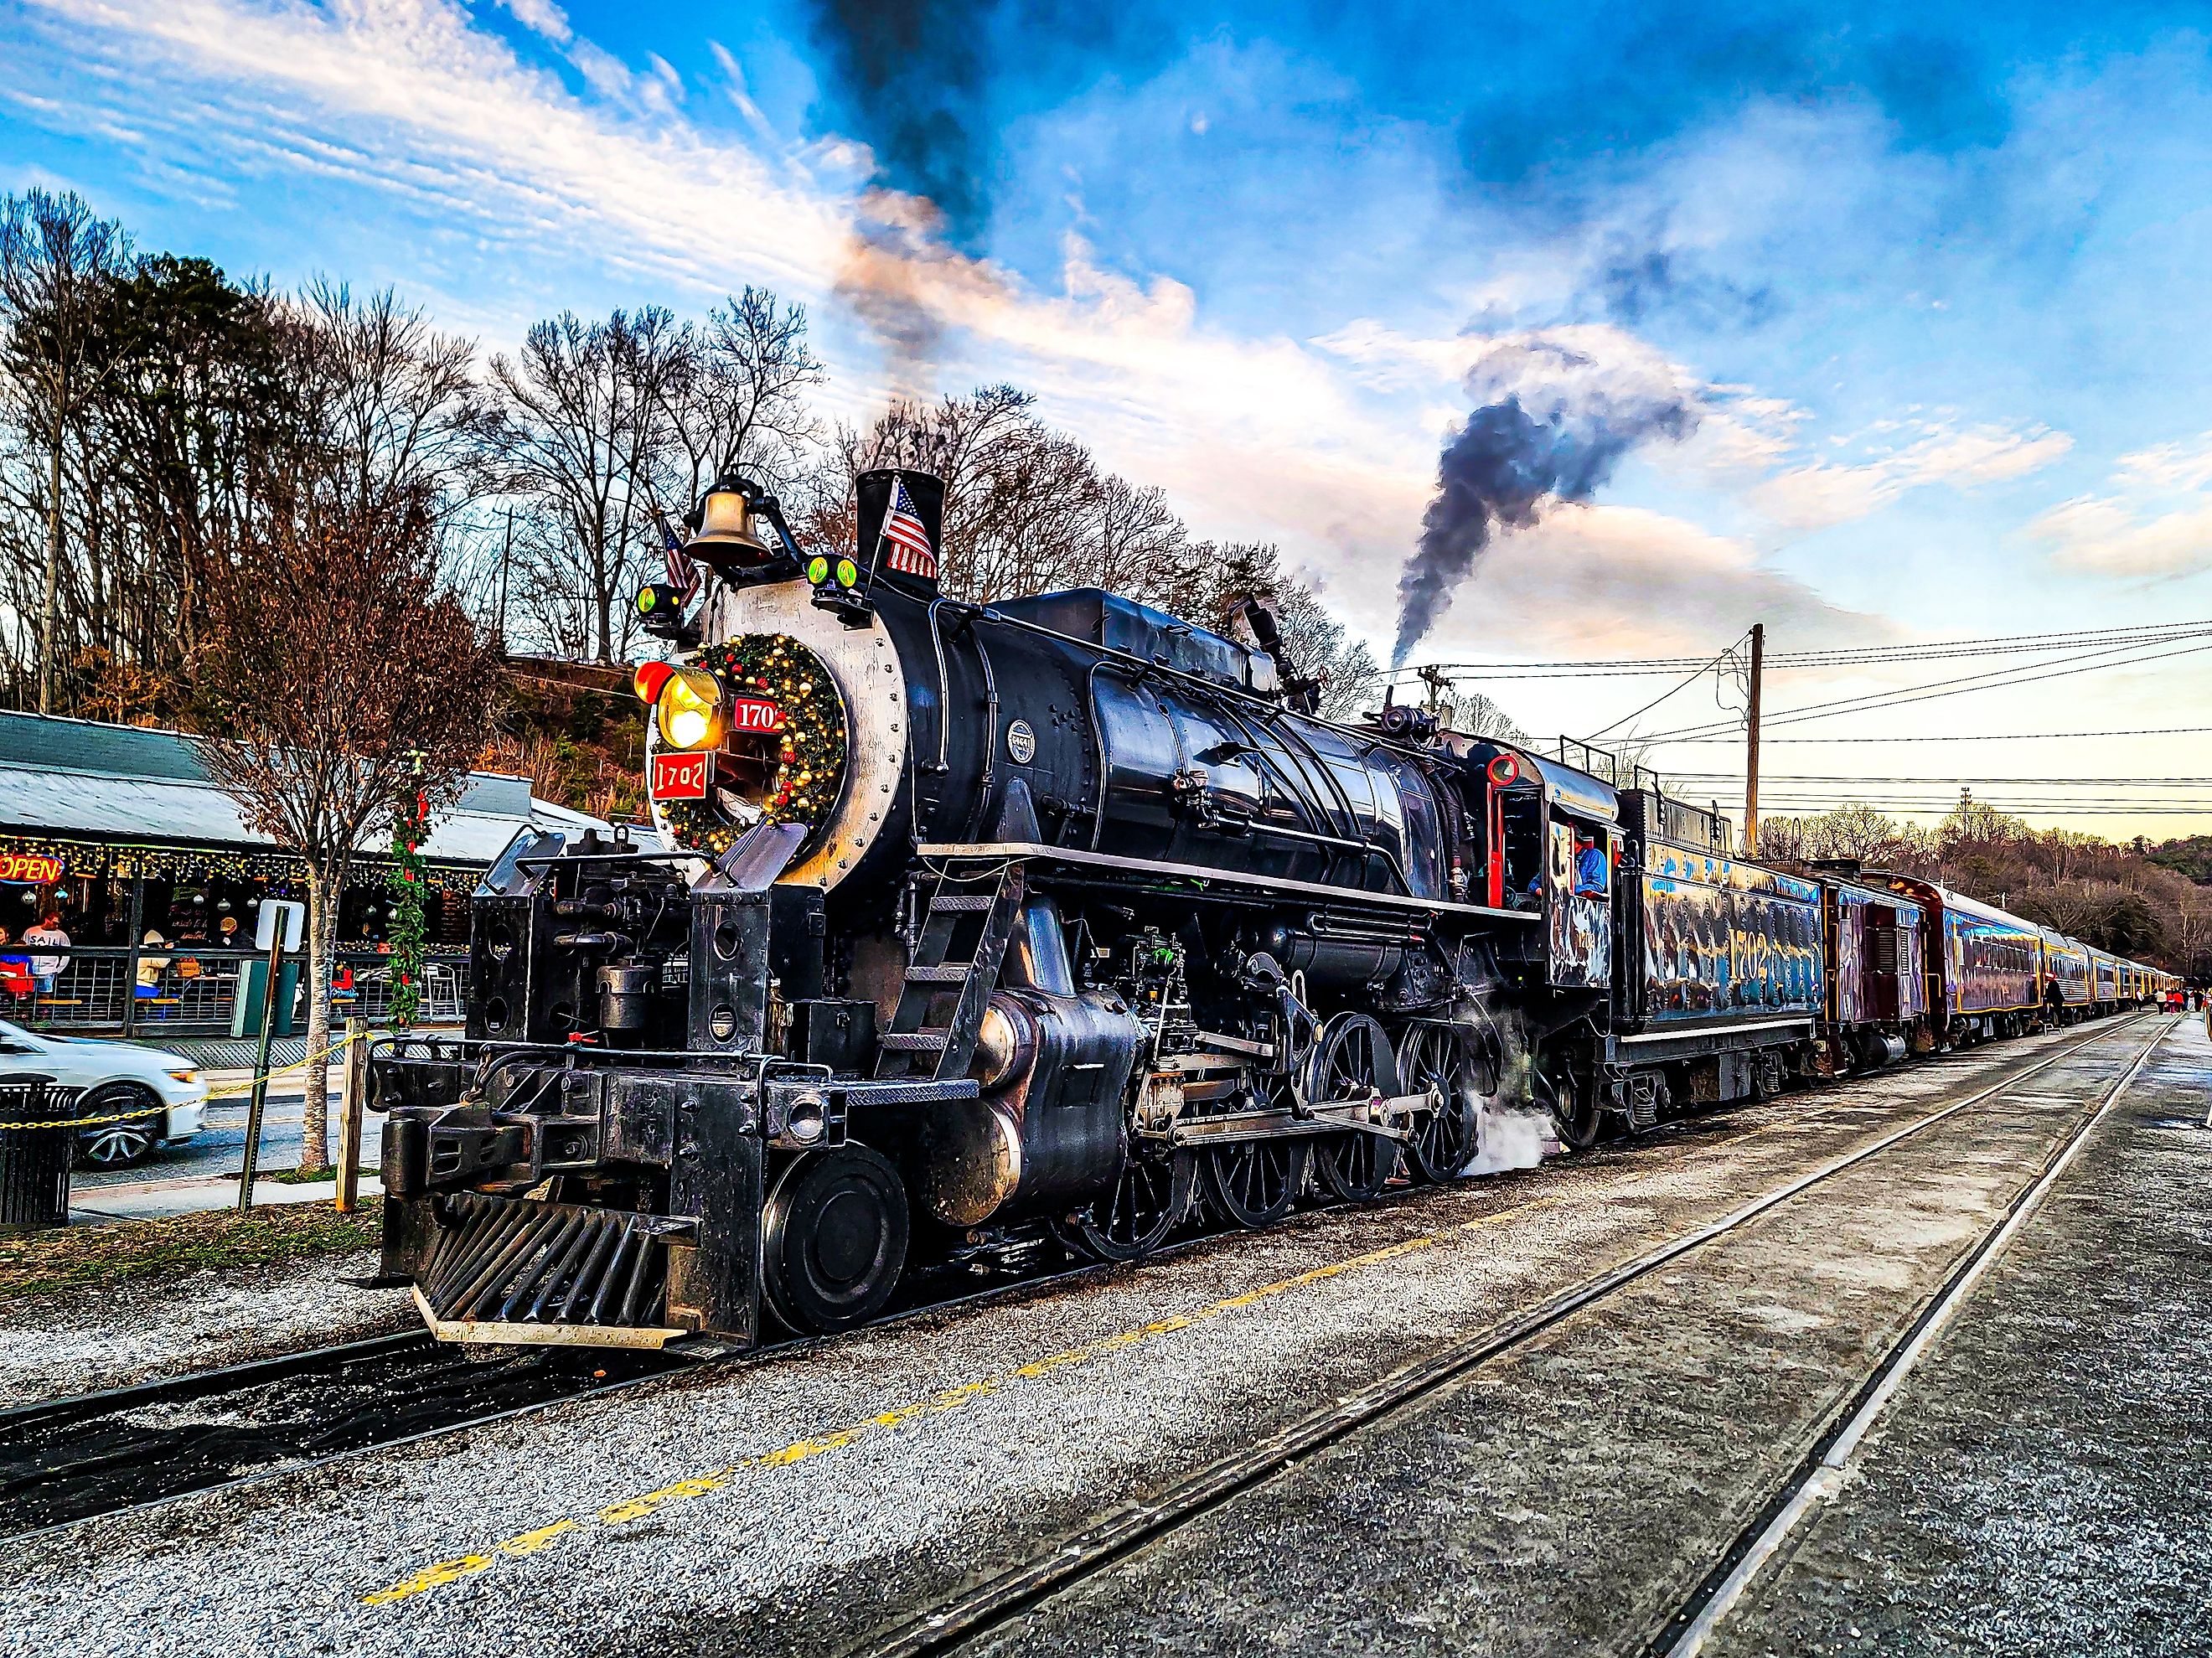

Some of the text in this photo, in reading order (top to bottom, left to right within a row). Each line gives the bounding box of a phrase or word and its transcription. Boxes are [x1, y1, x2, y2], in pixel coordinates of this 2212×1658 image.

[739, 704, 778, 728] 170
[656, 761, 703, 792] 1702
[0, 856, 59, 881] OPEN
[29, 935, 59, 946] SAIL
[1728, 928, 1767, 984] 1702
